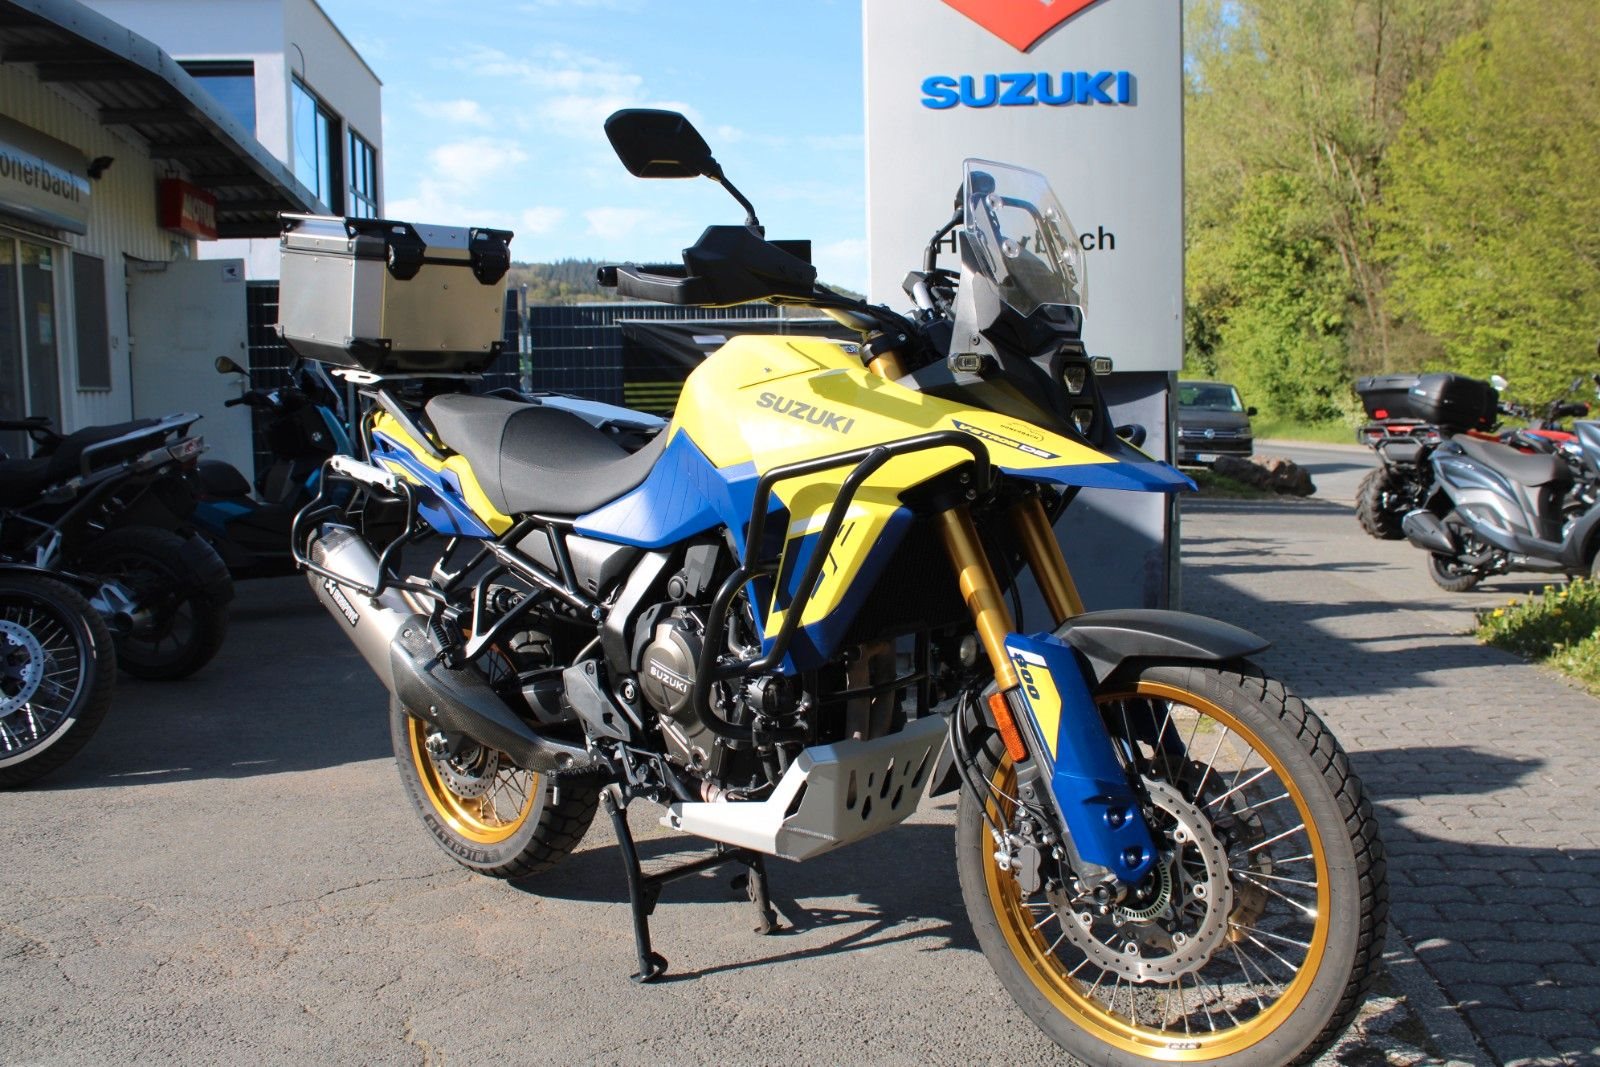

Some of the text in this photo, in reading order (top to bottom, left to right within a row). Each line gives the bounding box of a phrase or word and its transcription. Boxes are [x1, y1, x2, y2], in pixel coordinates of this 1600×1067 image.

[921, 71, 1130, 109] SUZUKI
[756, 391, 855, 434] SUZUKI
[650, 666, 688, 693] SUZUKI
[1013, 652, 1040, 700] 800
[425, 815, 488, 862] MICHELIN
